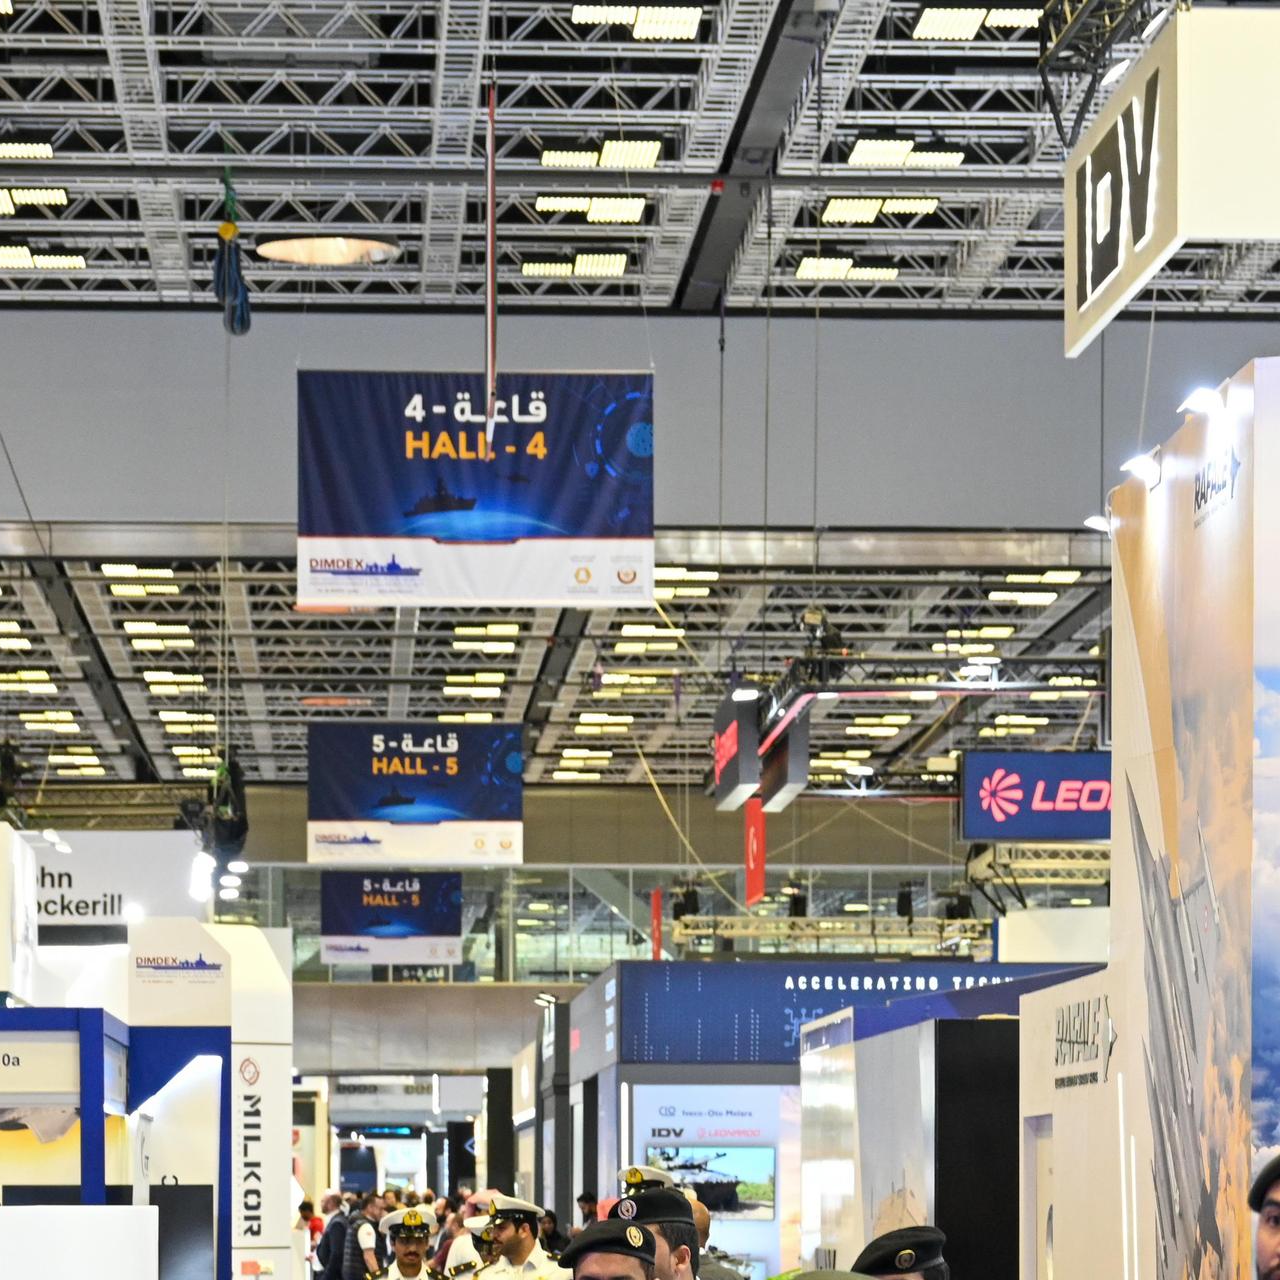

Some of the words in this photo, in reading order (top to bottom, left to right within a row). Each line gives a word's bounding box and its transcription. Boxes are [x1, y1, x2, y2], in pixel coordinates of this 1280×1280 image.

[1076, 66, 1160, 312] IDV
[526, 431, 548, 460] 4
[309, 558, 364, 570] DIMDEX
[372, 757, 428, 775] HALL
[445, 757, 459, 775] 5
[1031, 780, 1111, 811] LEO
[37, 866, 73, 888] hn
[362, 893, 400, 906] HALL
[135, 956, 178, 966] DIMDEX
[651, 1128, 684, 1138] IDV
[243, 1094, 262, 1237] MILKOR
